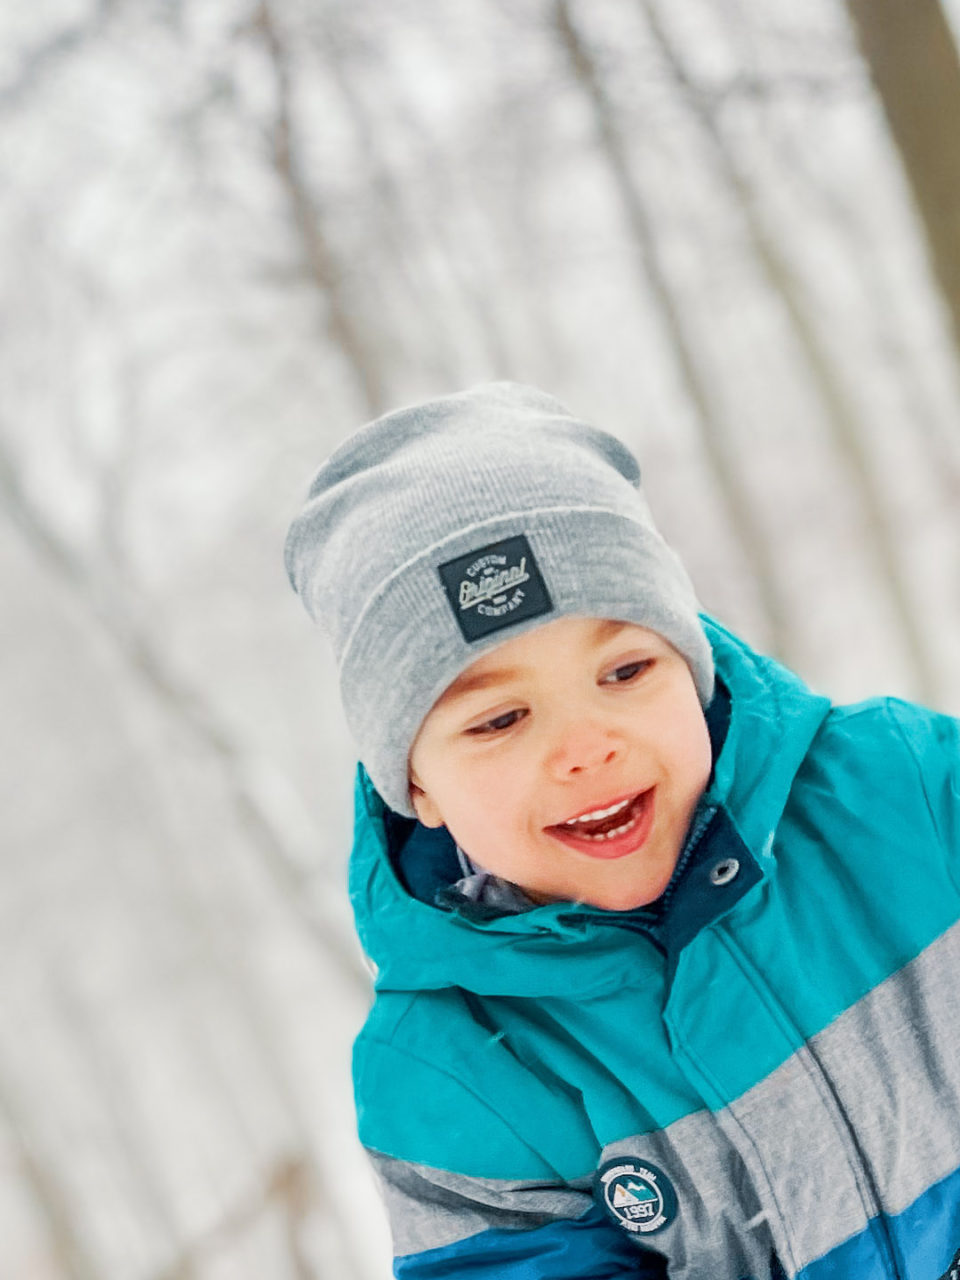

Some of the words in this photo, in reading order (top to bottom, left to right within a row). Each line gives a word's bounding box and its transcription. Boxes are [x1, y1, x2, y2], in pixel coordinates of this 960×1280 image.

[460, 557, 529, 608] Original
[478, 588, 525, 616] COMPANY
[624, 1203, 654, 1219] 1997
